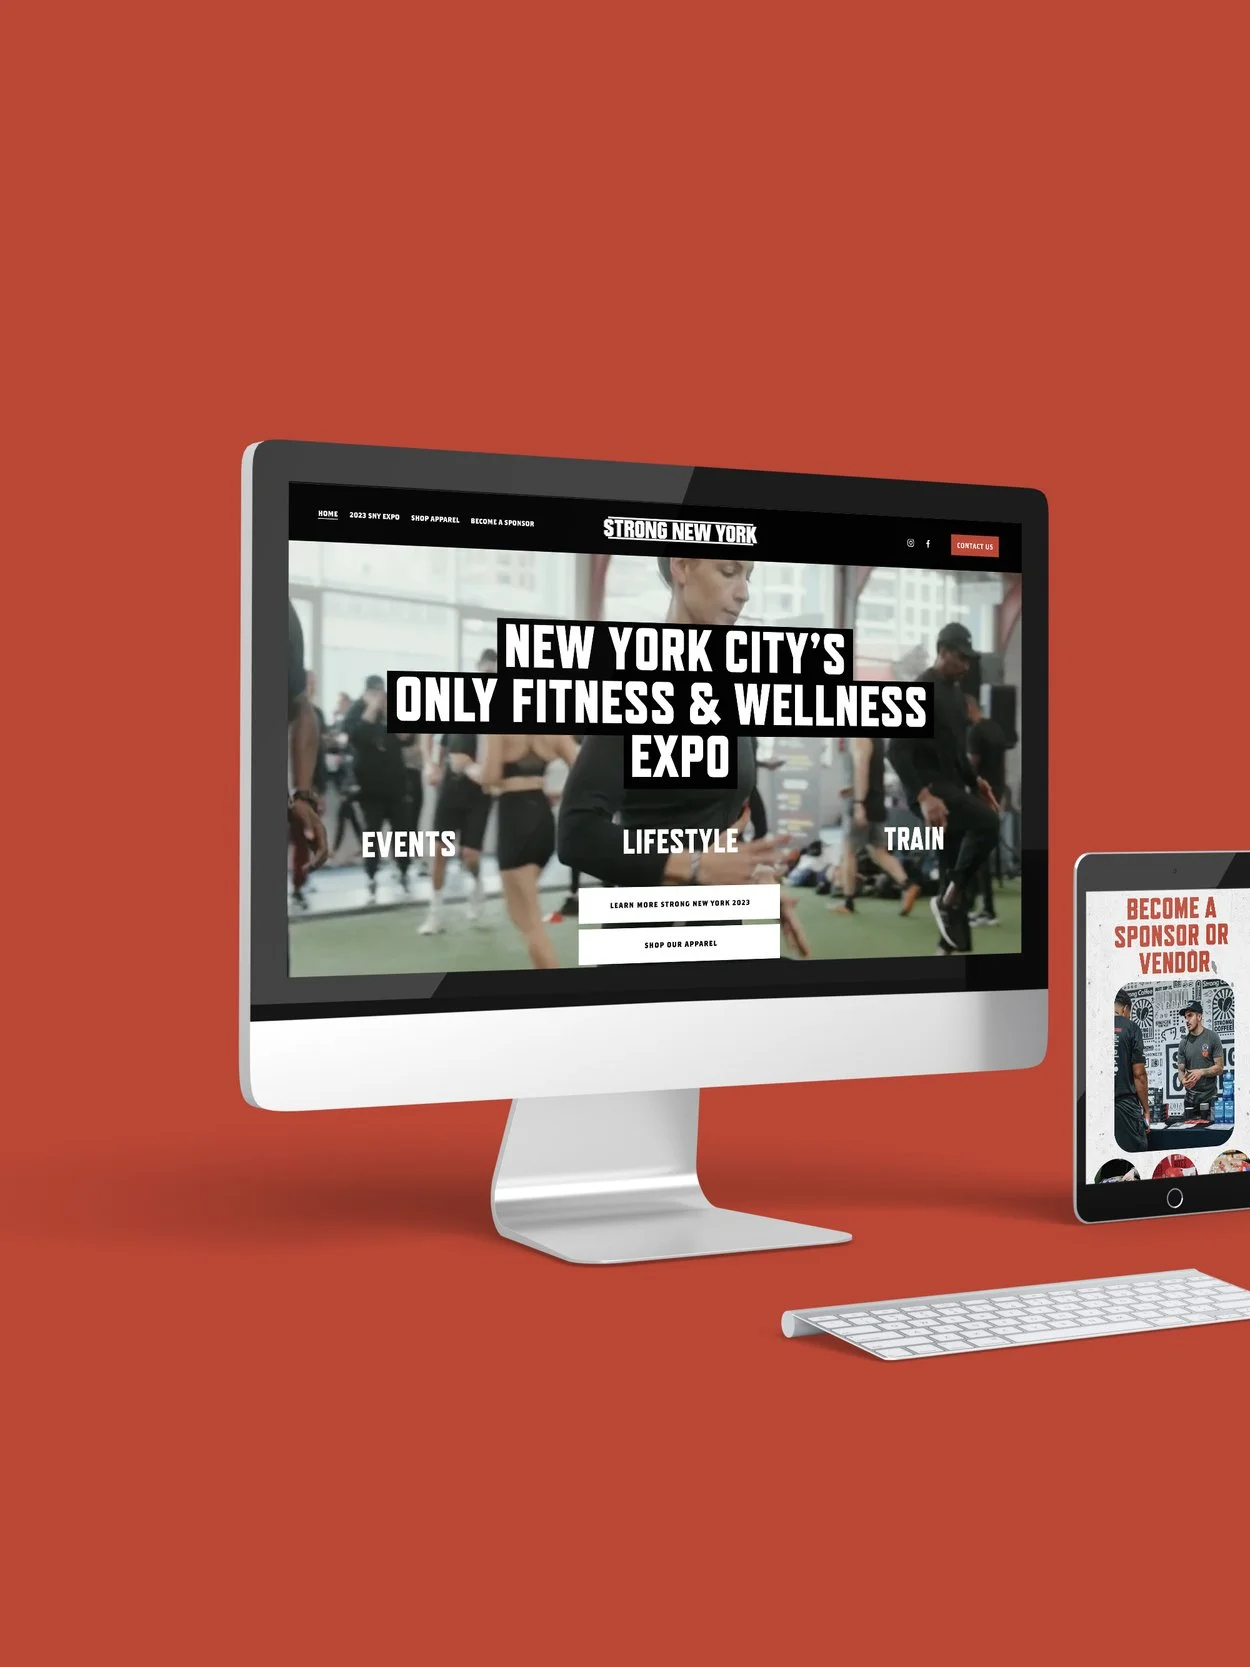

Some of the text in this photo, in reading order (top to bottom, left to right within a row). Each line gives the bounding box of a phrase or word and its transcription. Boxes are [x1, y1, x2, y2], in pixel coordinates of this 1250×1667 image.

[430, 515, 460, 524] APPAREL
[470, 517, 498, 526] BECOME
[604, 518, 757, 544] STRONG NEW YORK
[507, 624, 844, 674] NEW YORK CITY’S
[397, 677, 925, 726] ONLY FITNESS & WELLNESS
[633, 735, 728, 777] EXPO
[363, 831, 455, 857] EVENTS
[624, 829, 737, 853] LIFESTYLE
[885, 827, 943, 850] TRAIN
[1127, 896, 1217, 921] BECOME A
[1114, 923, 1229, 948] SPONSOR OR
[1139, 950, 1210, 974] VENDOR
